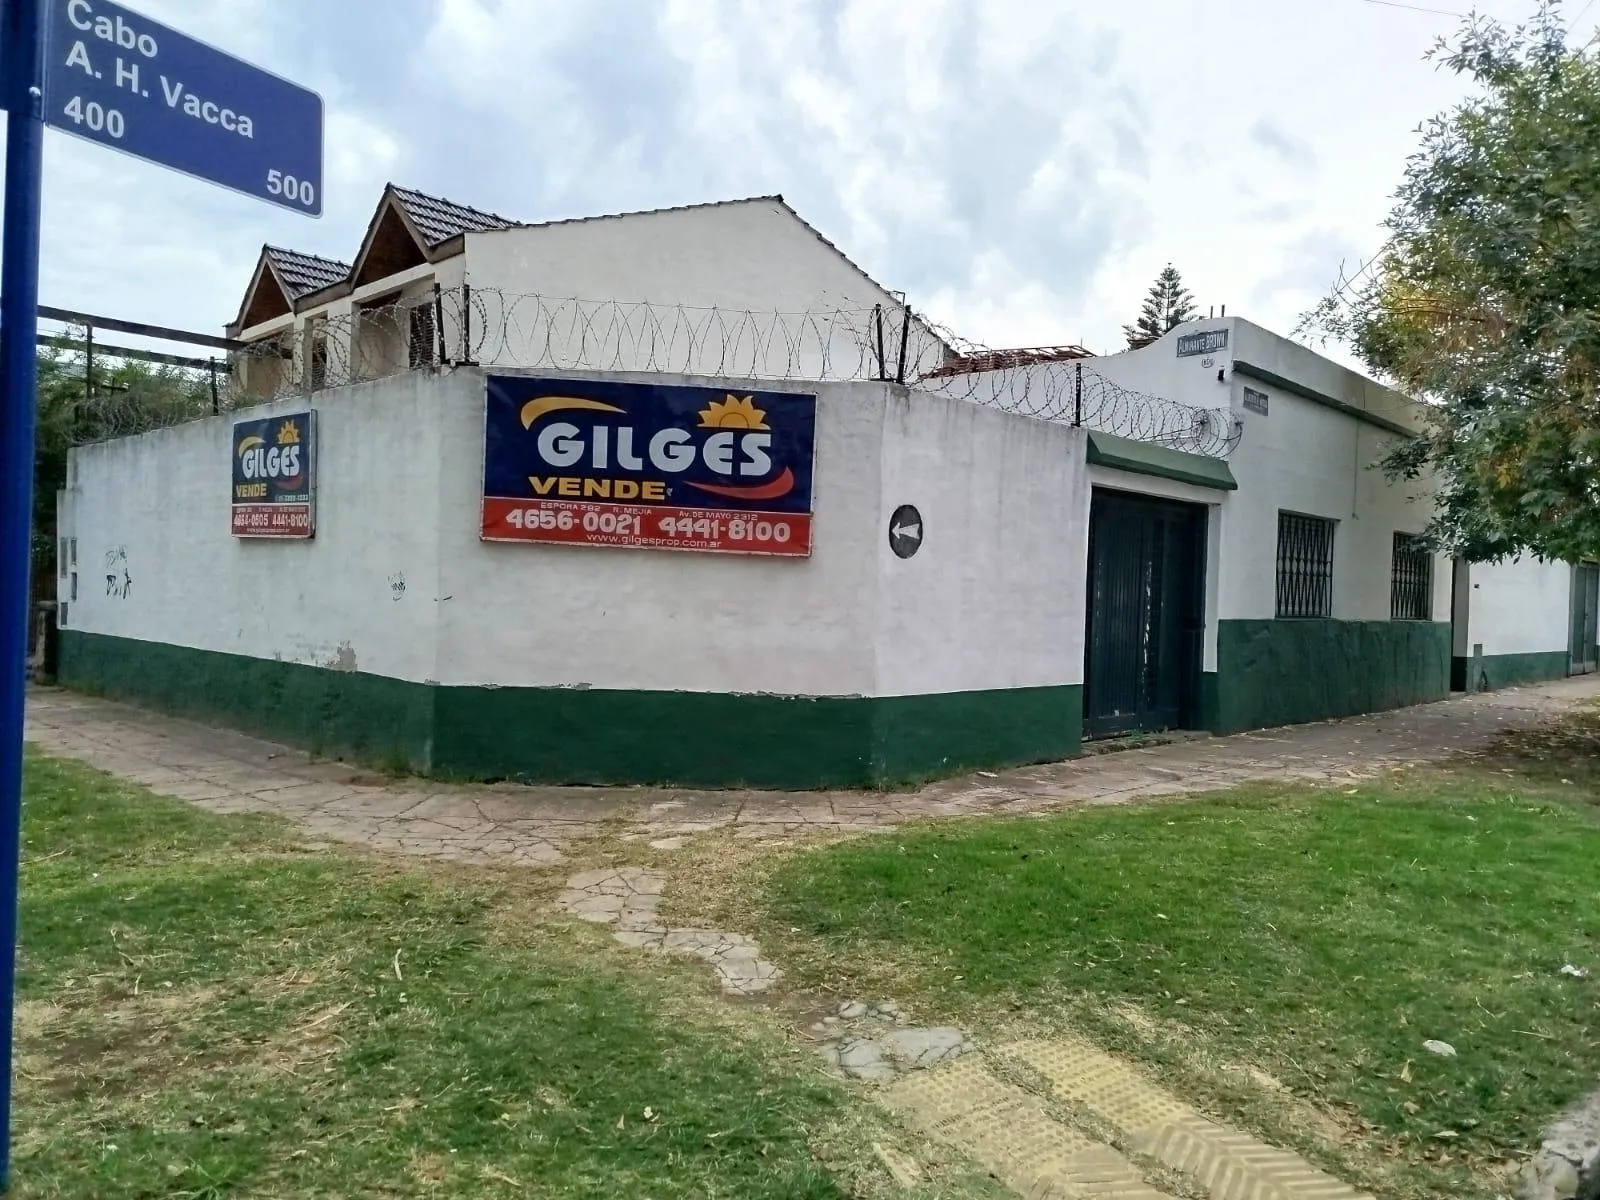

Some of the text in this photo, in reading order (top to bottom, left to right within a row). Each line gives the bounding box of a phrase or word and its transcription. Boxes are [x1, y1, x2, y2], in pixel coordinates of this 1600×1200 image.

[67, 0, 158, 58] Cabo
[65, 40, 253, 139] A. H. Vacca
[63, 95, 125, 138] 400
[266, 168, 314, 206] 500
[242, 445, 300, 479] GILGES
[537, 422, 772, 476] GILGES
[235, 483, 267, 498] VENDE
[527, 476, 666, 500] VENDE
[272, 513, 308, 527] 4441-8100
[505, 508, 791, 543] 4656-0021 4441-8100
[540, 502, 578, 511] ESPORA
[692, 511, 704, 519] DE
[706, 512, 731, 520] MAYO
[733, 513, 758, 521] 2312
[586, 533, 722, 549] www.gilgesprop.com.ar
